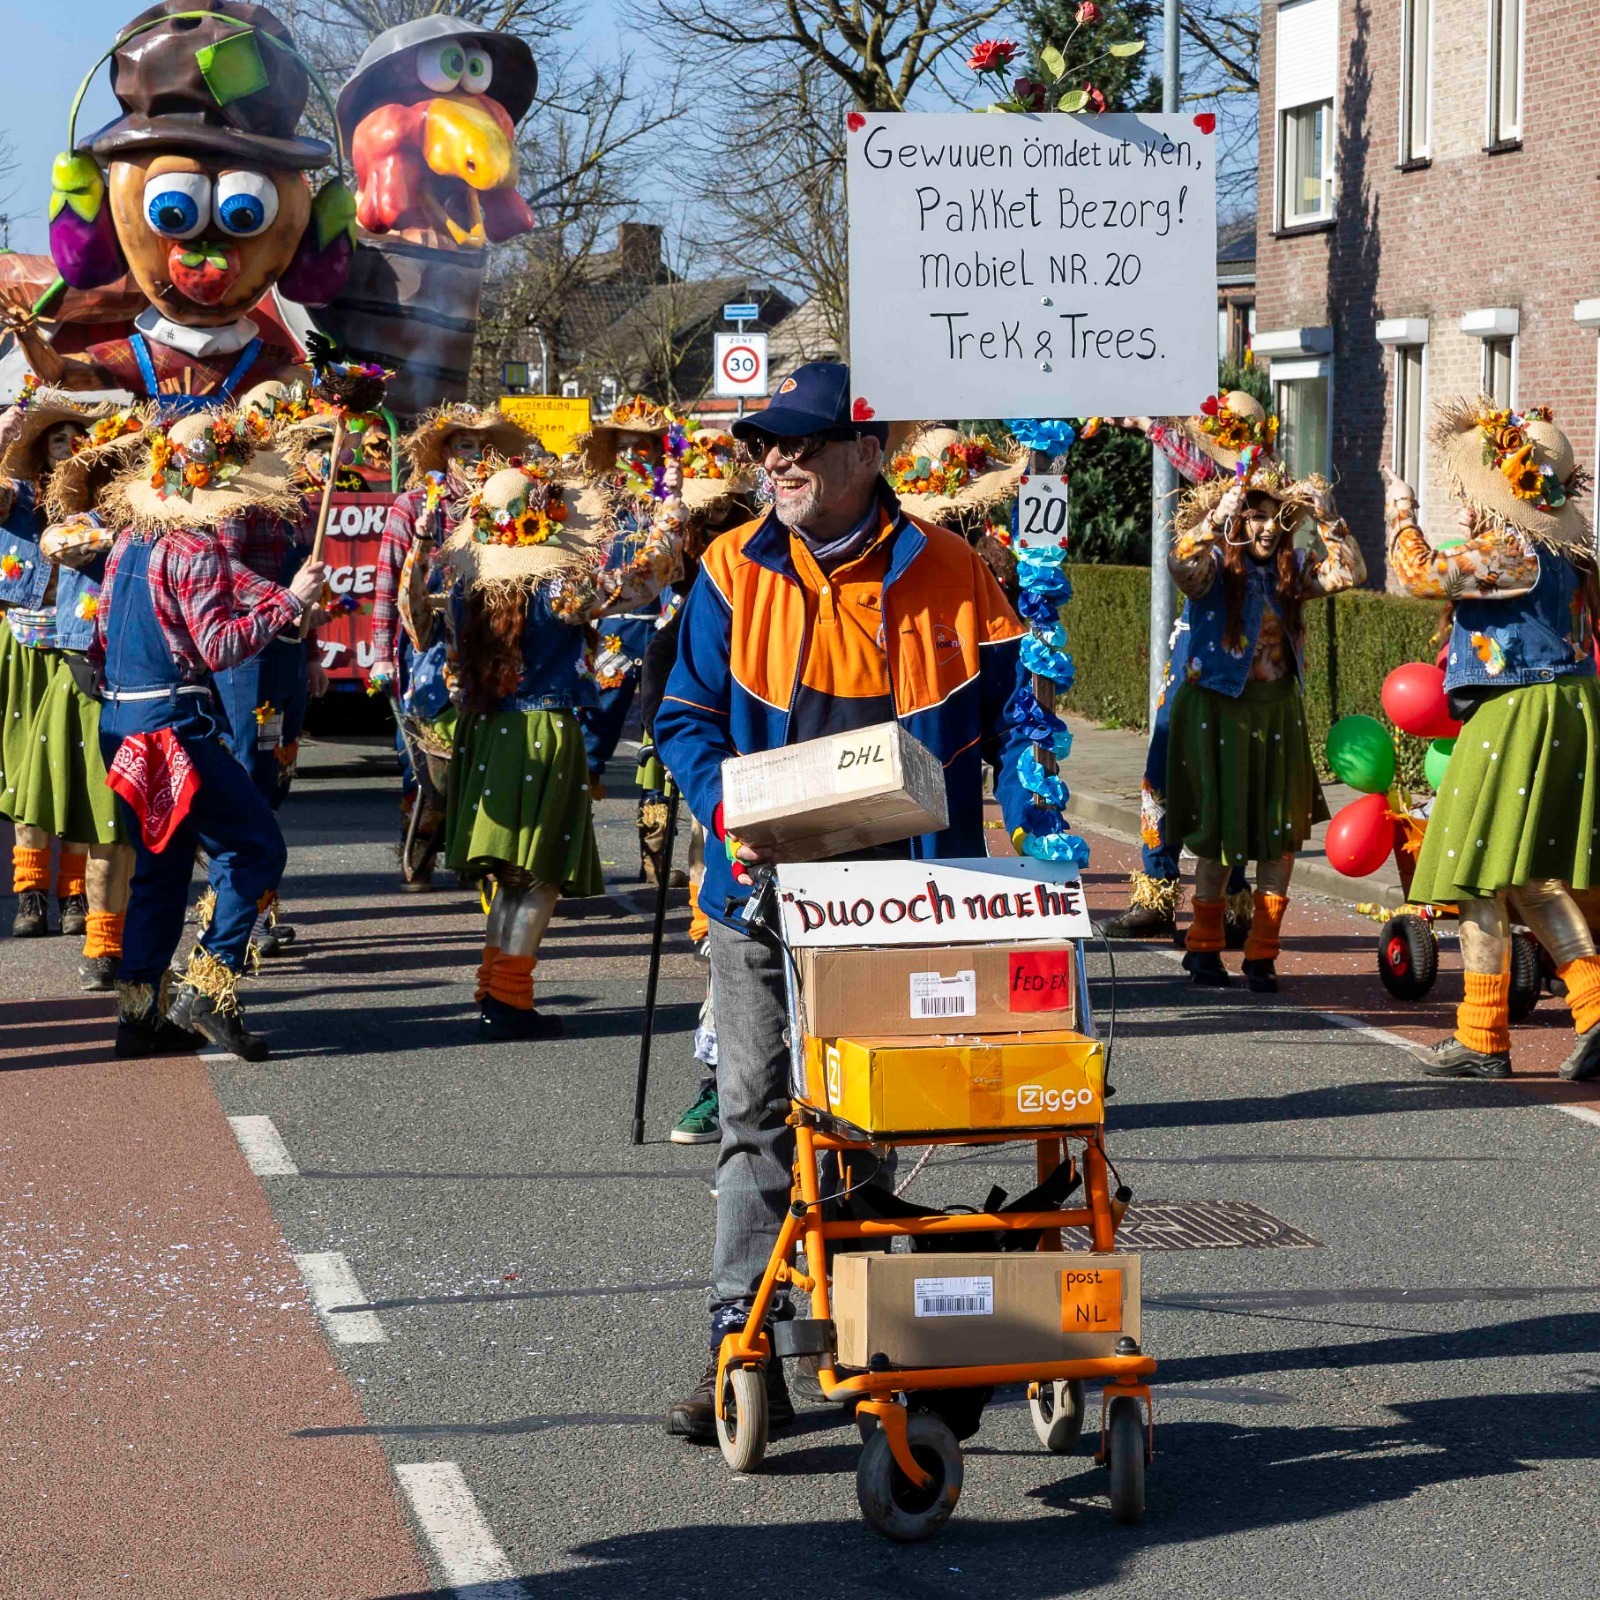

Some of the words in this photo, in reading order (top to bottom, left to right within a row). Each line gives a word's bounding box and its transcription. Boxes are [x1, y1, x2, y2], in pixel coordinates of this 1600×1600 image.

[863, 126, 1013, 169] Gewuuen
[1059, 185, 1188, 236] Bezorg!
[1059, 312, 1166, 360] Trees.
[730, 357, 754, 372] 30
[1024, 496, 1067, 535] 20
[837, 745, 885, 770] DHL
[1066, 1270, 1103, 1292] post
[1076, 1303, 1107, 1324] NL
